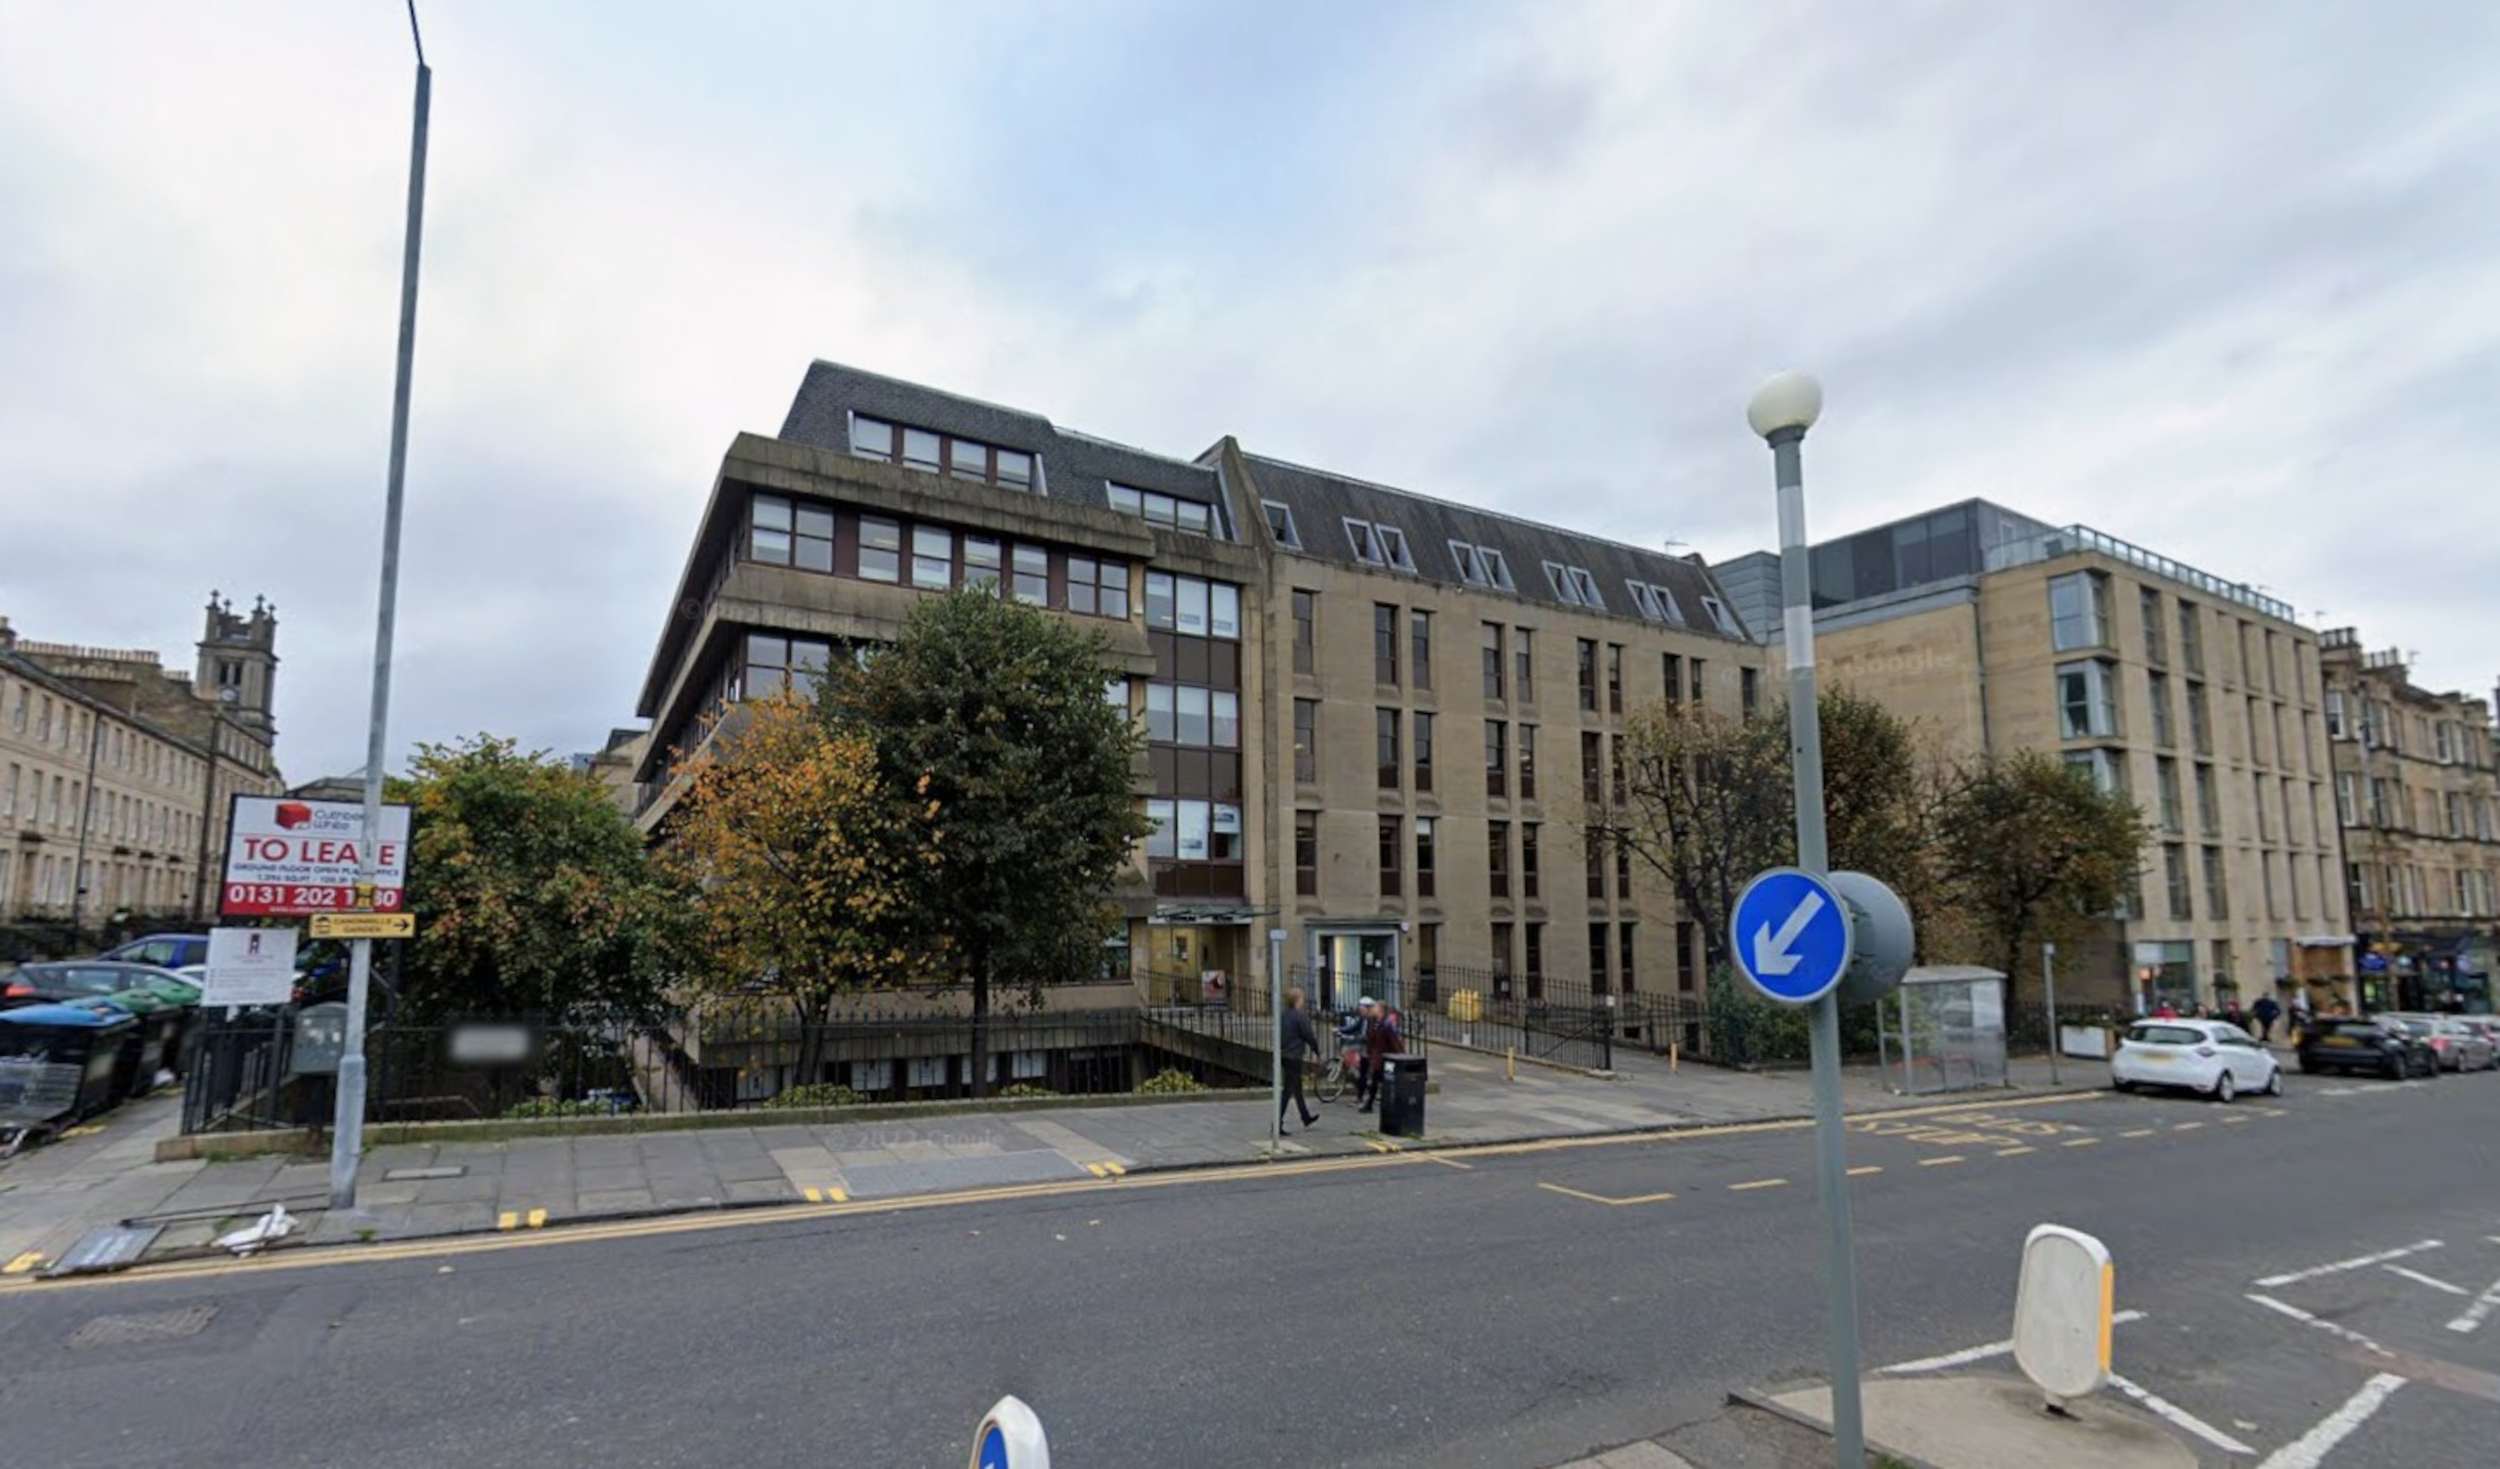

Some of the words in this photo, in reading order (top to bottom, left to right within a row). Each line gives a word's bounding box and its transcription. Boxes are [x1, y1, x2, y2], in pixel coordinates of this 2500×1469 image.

[244, 838, 289, 862] TO
[301, 841, 395, 866] LEAE
[229, 884, 285, 904] 0131
[293, 888, 336, 906] 202
